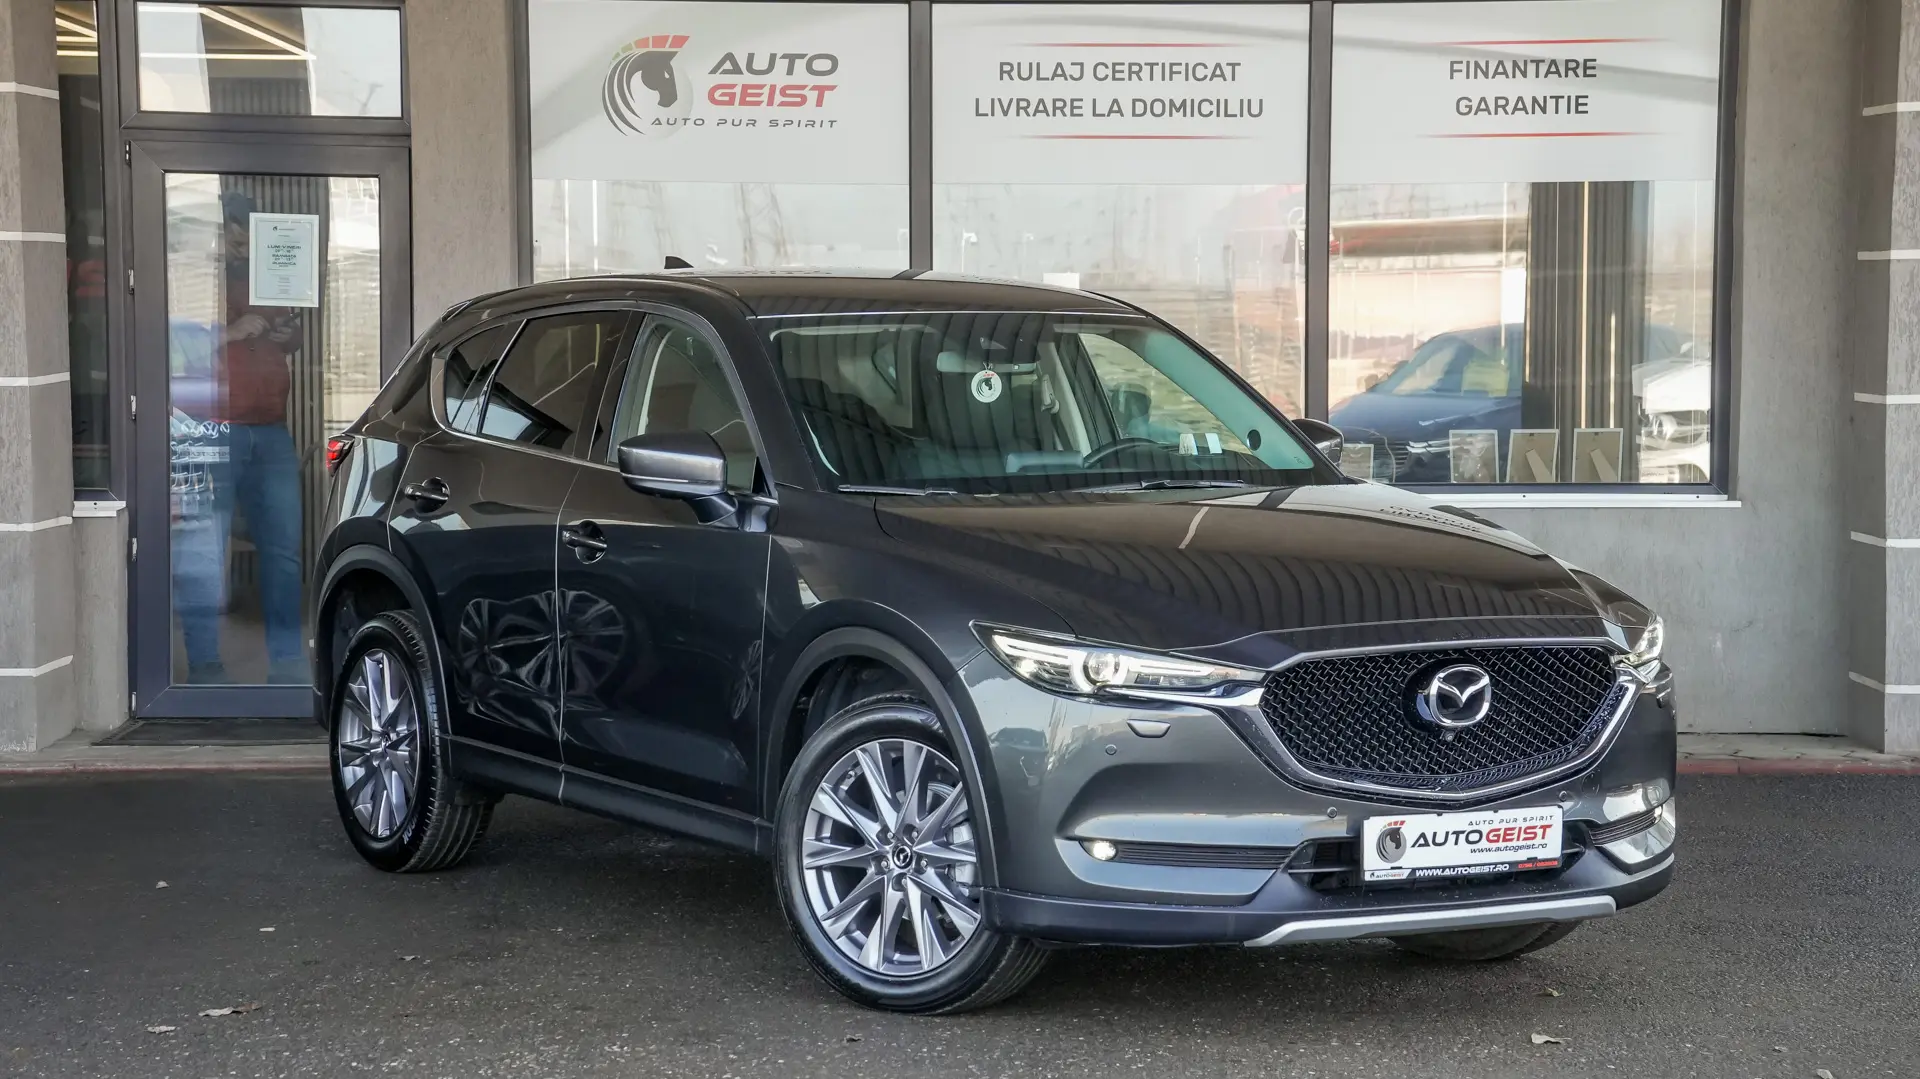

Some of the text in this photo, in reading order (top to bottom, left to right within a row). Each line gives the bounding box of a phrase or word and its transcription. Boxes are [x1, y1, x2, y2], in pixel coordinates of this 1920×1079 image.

[708, 52, 839, 76] AUTO
[999, 62, 1241, 82] RULAJ CERTIFICAT
[1449, 58, 1597, 80] FINANTARE
[707, 83, 838, 108] GEIST
[1455, 95, 1589, 116] GARANTIE
[975, 98, 1264, 118] LIVRARE LA DOMICILIU
[651, 117, 838, 128] AUTO PUR SPIRIT
[1470, 843, 1548, 854] www.autogeist.ro
[1415, 864, 1510, 877] WWW.AUTOGEIST.RO
